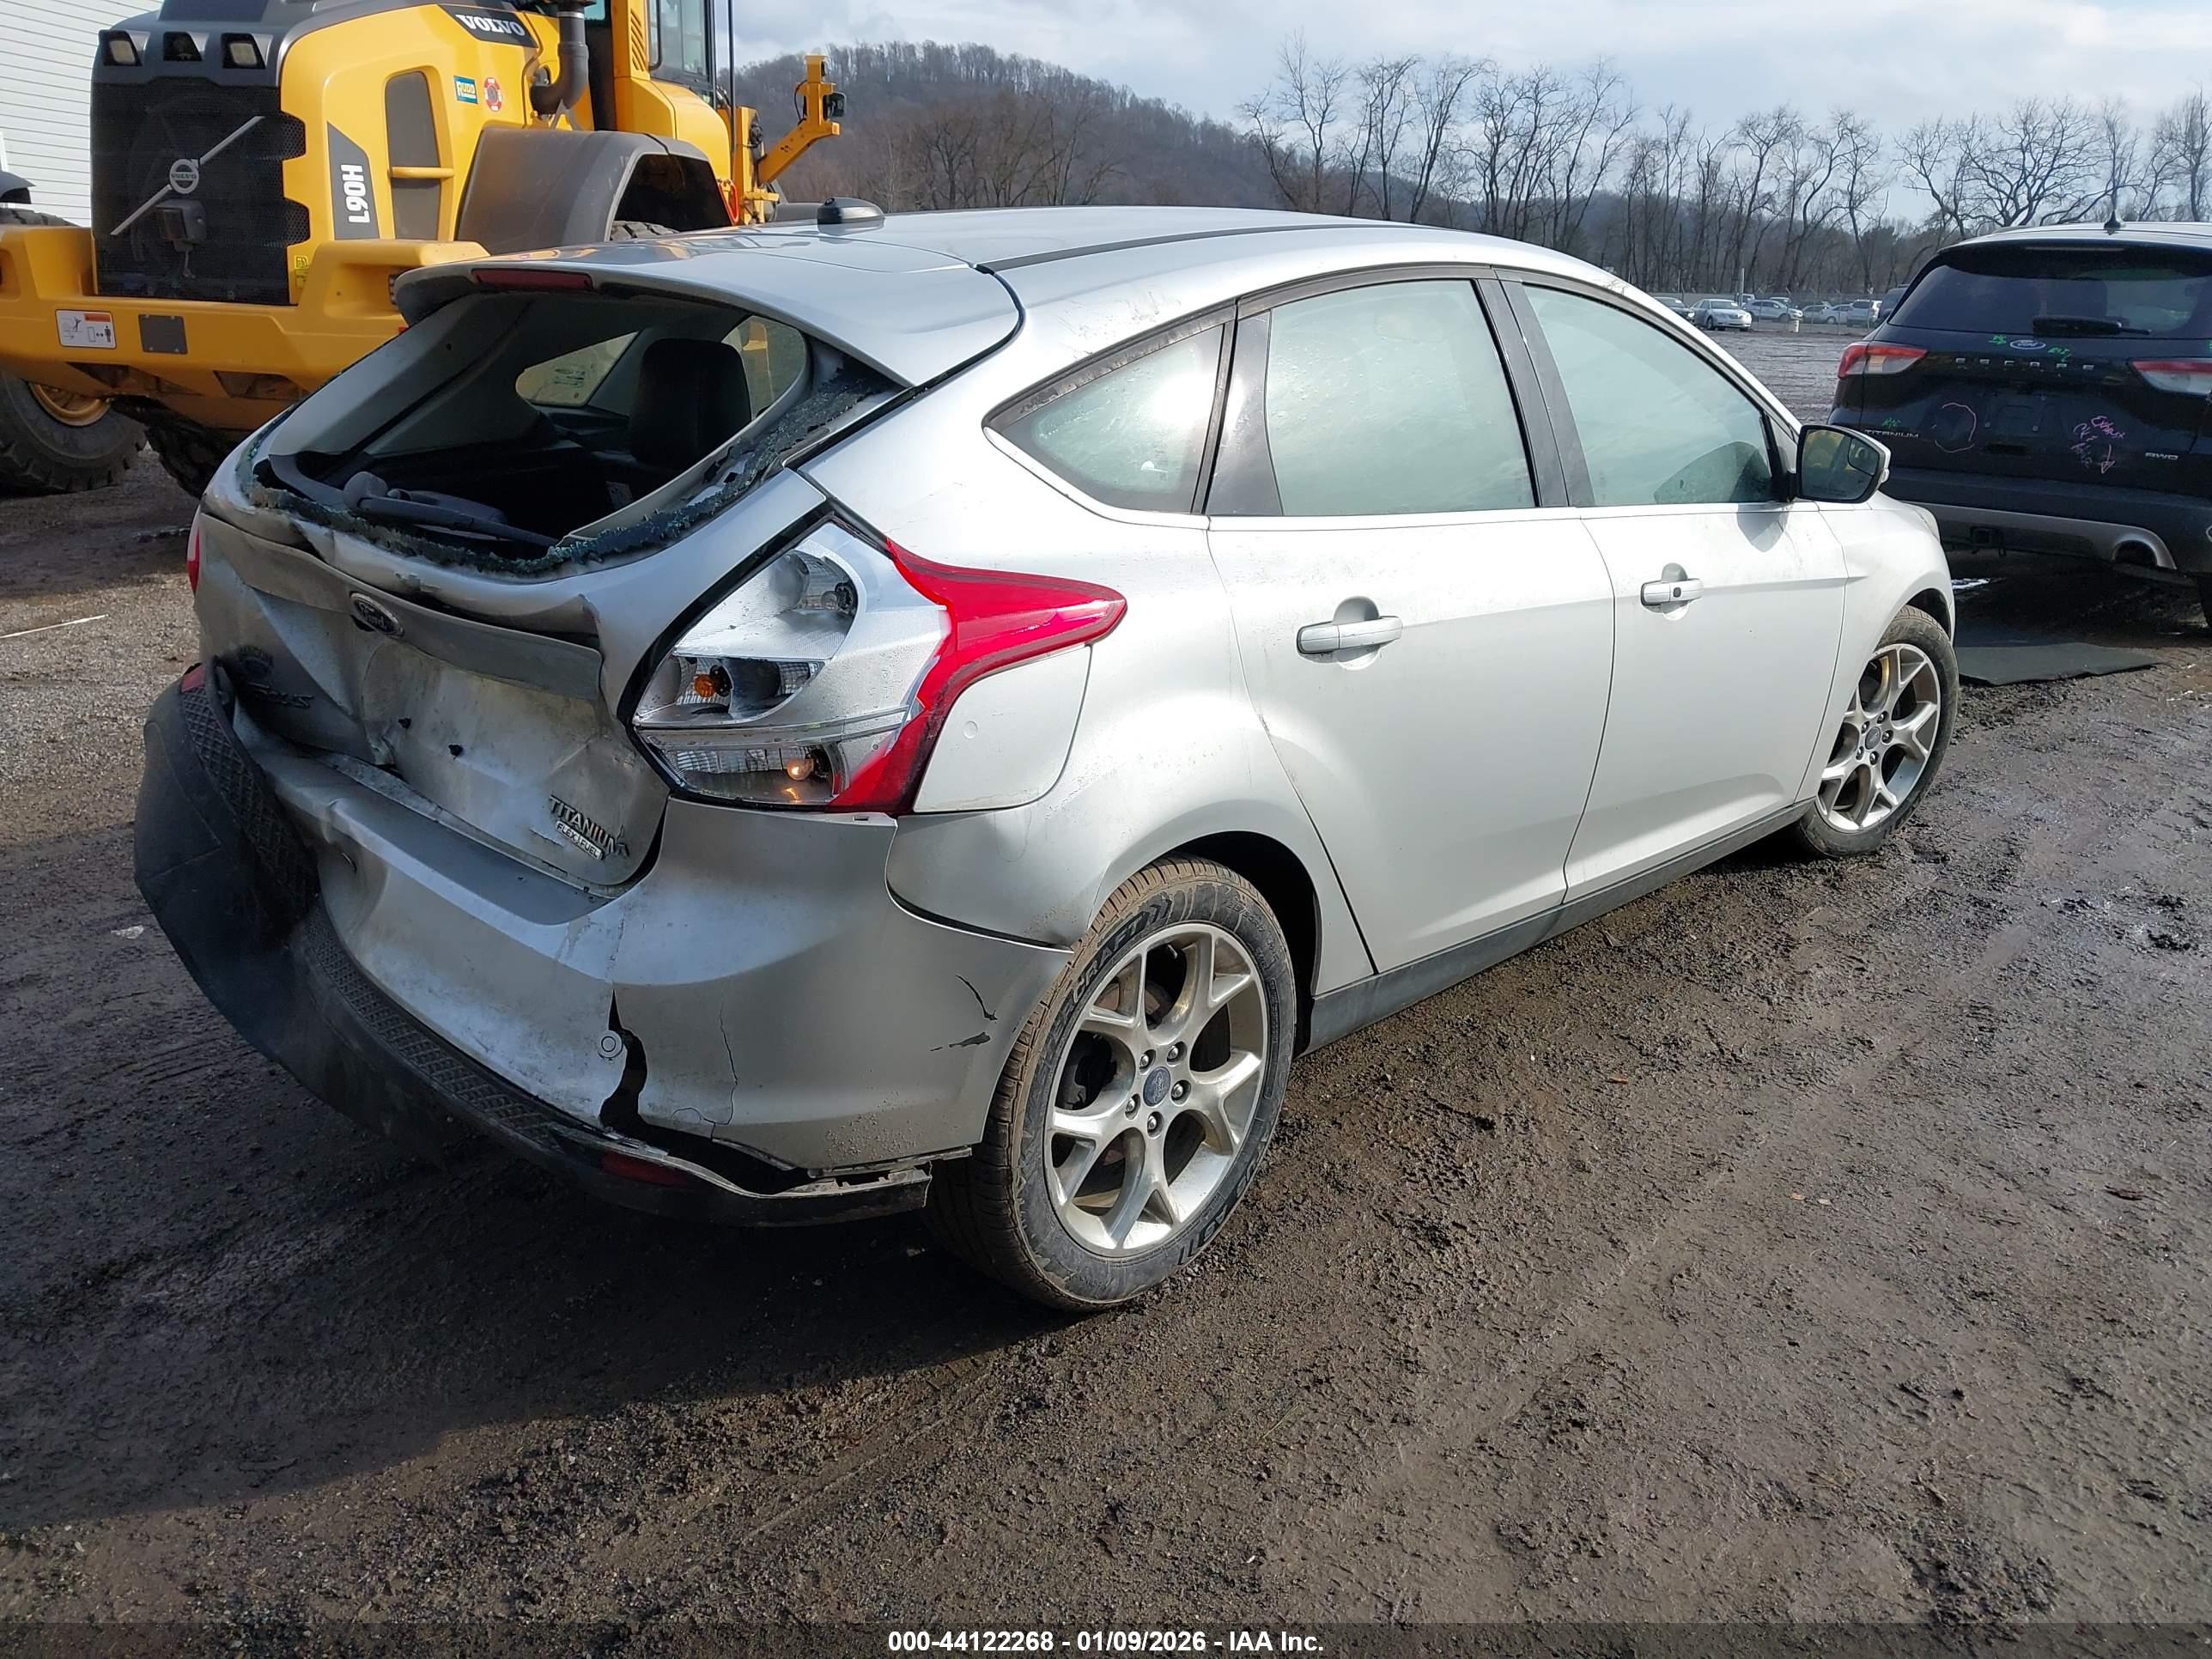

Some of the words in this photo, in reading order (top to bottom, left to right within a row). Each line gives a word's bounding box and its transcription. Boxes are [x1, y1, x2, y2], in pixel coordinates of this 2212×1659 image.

[454, 14, 526, 36] VOLVO
[340, 164, 371, 223] L90H
[1864, 429, 1919, 438] TITANIUM
[2145, 452, 2179, 460] AWD
[549, 794, 630, 857] TITANIUM
[556, 822, 578, 842] FLEX
[580, 839, 599, 858] FUEL
